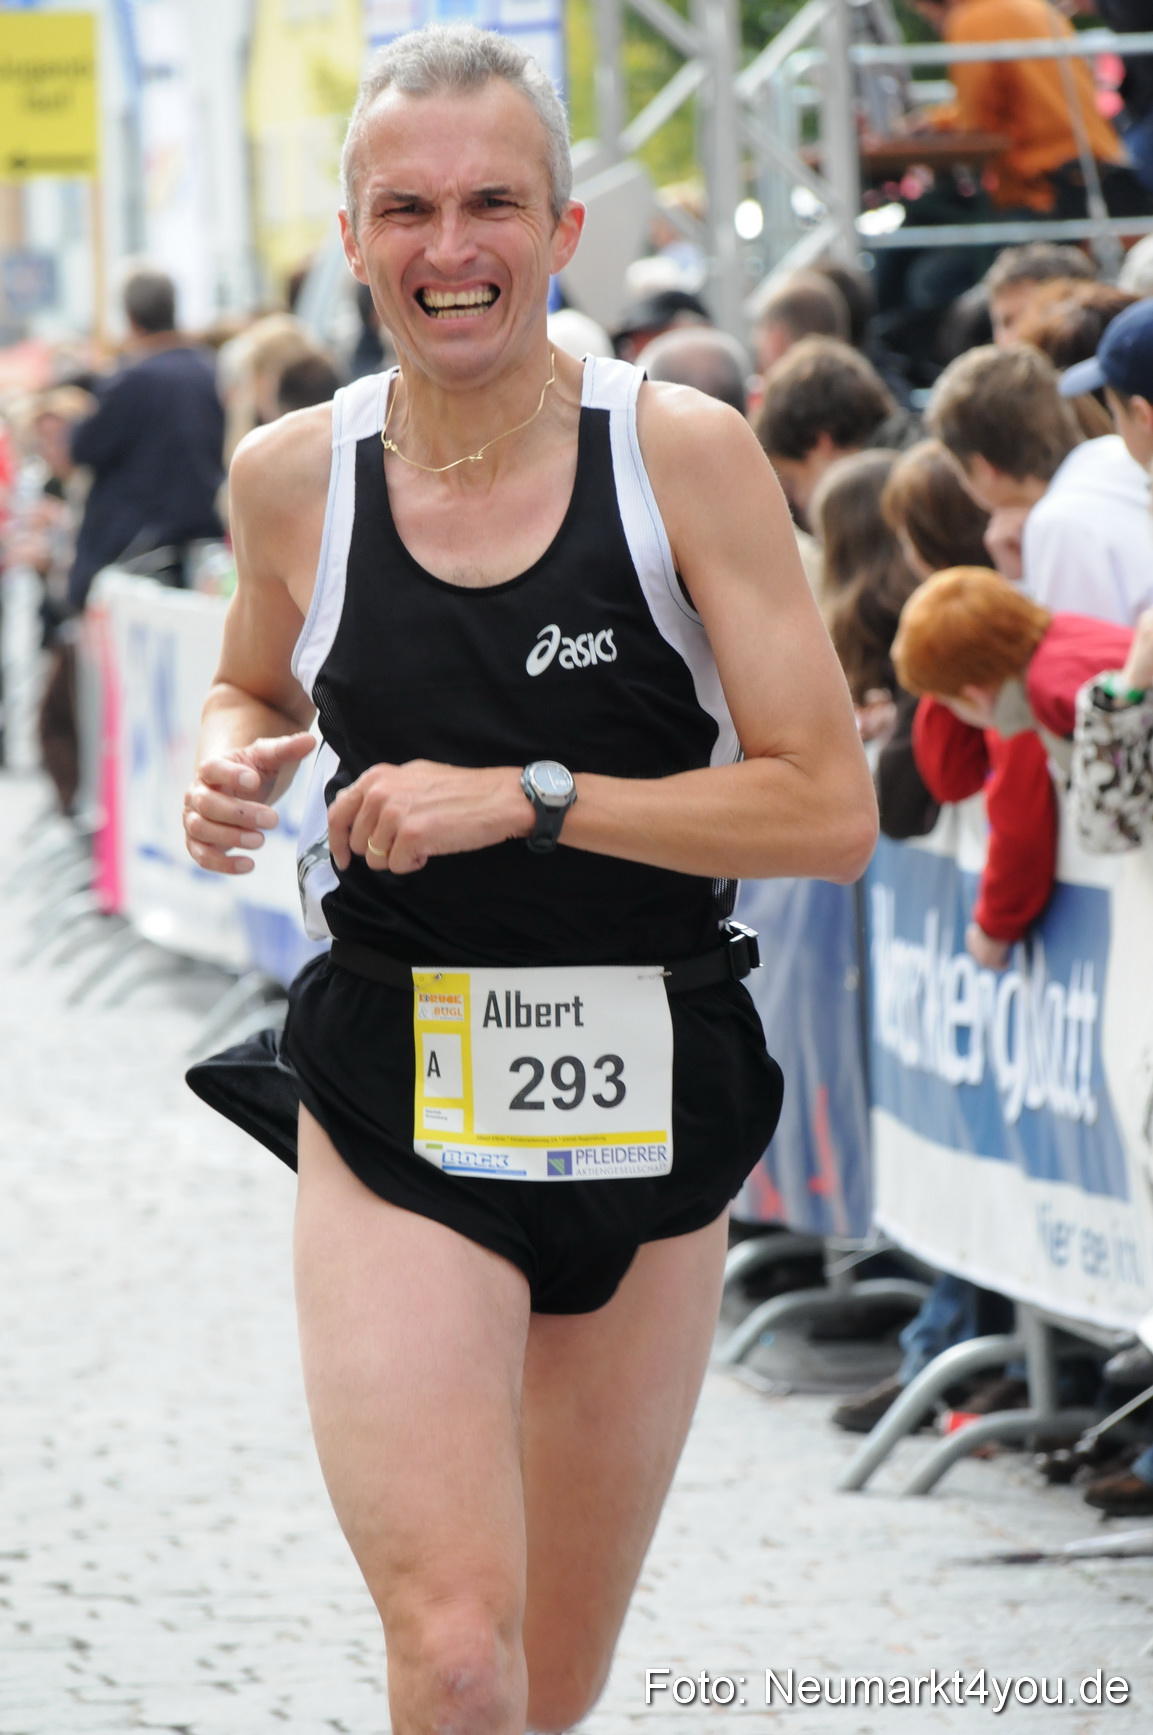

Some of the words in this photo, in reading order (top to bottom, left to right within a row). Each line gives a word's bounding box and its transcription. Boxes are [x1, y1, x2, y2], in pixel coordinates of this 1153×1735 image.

[482, 990, 584, 1028] Albert
[427, 1050, 441, 1078] A
[509, 1054, 627, 1112] 293
[442, 1150, 509, 1168] BOCK
[576, 1145, 668, 1165] PFLEIDERER
